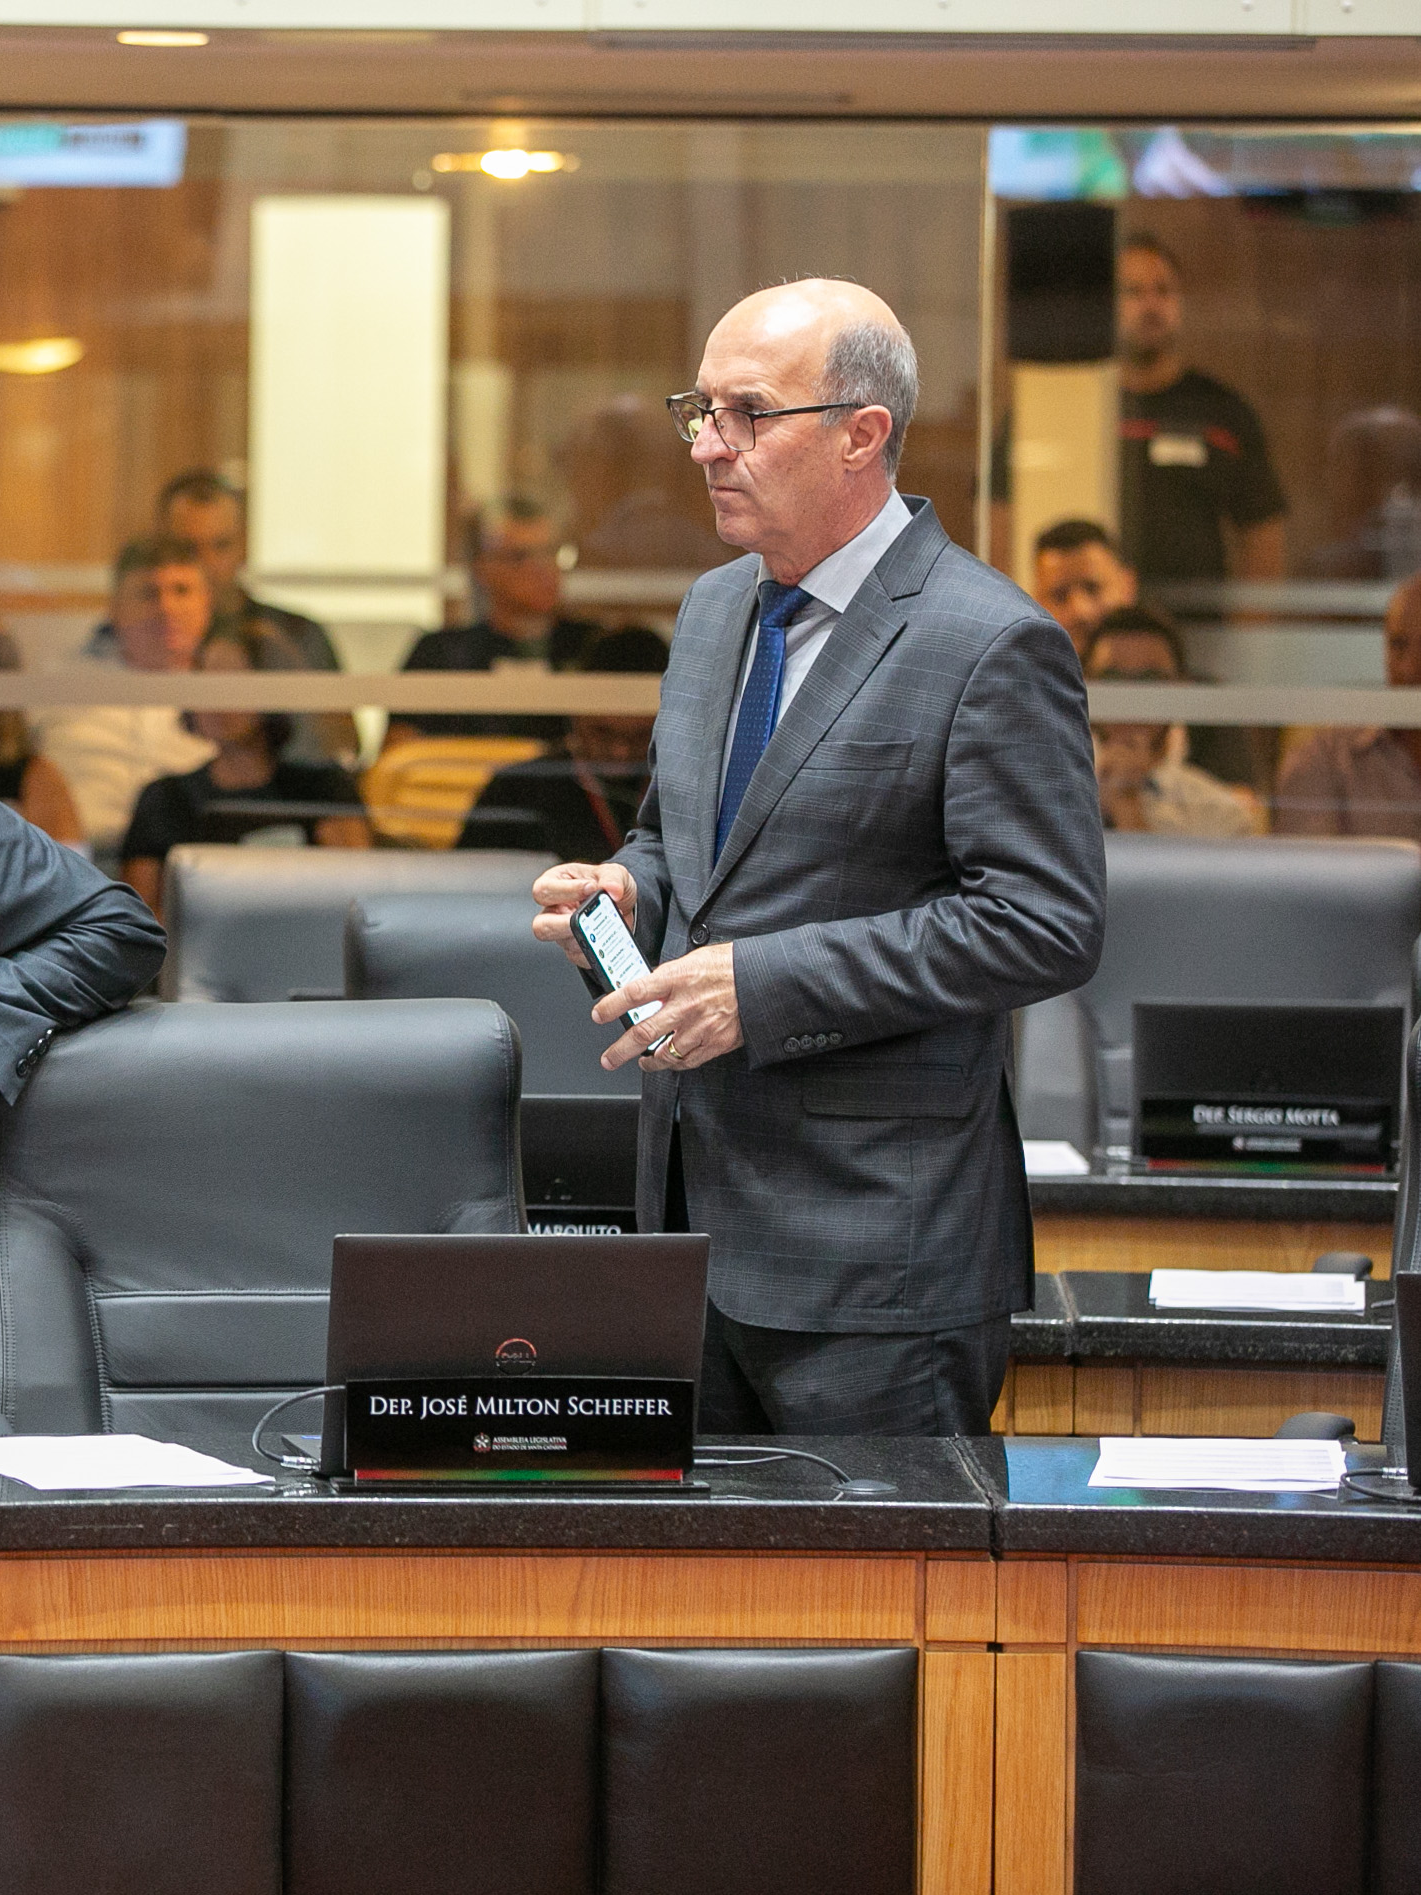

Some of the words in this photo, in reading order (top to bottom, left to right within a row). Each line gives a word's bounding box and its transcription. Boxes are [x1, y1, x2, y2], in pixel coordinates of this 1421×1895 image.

[369, 1396, 413, 1415] DEP.
[420, 1395, 467, 1420] JOSÉ
[475, 1396, 559, 1415] MILTON
[567, 1396, 672, 1416] SCHEFFER
